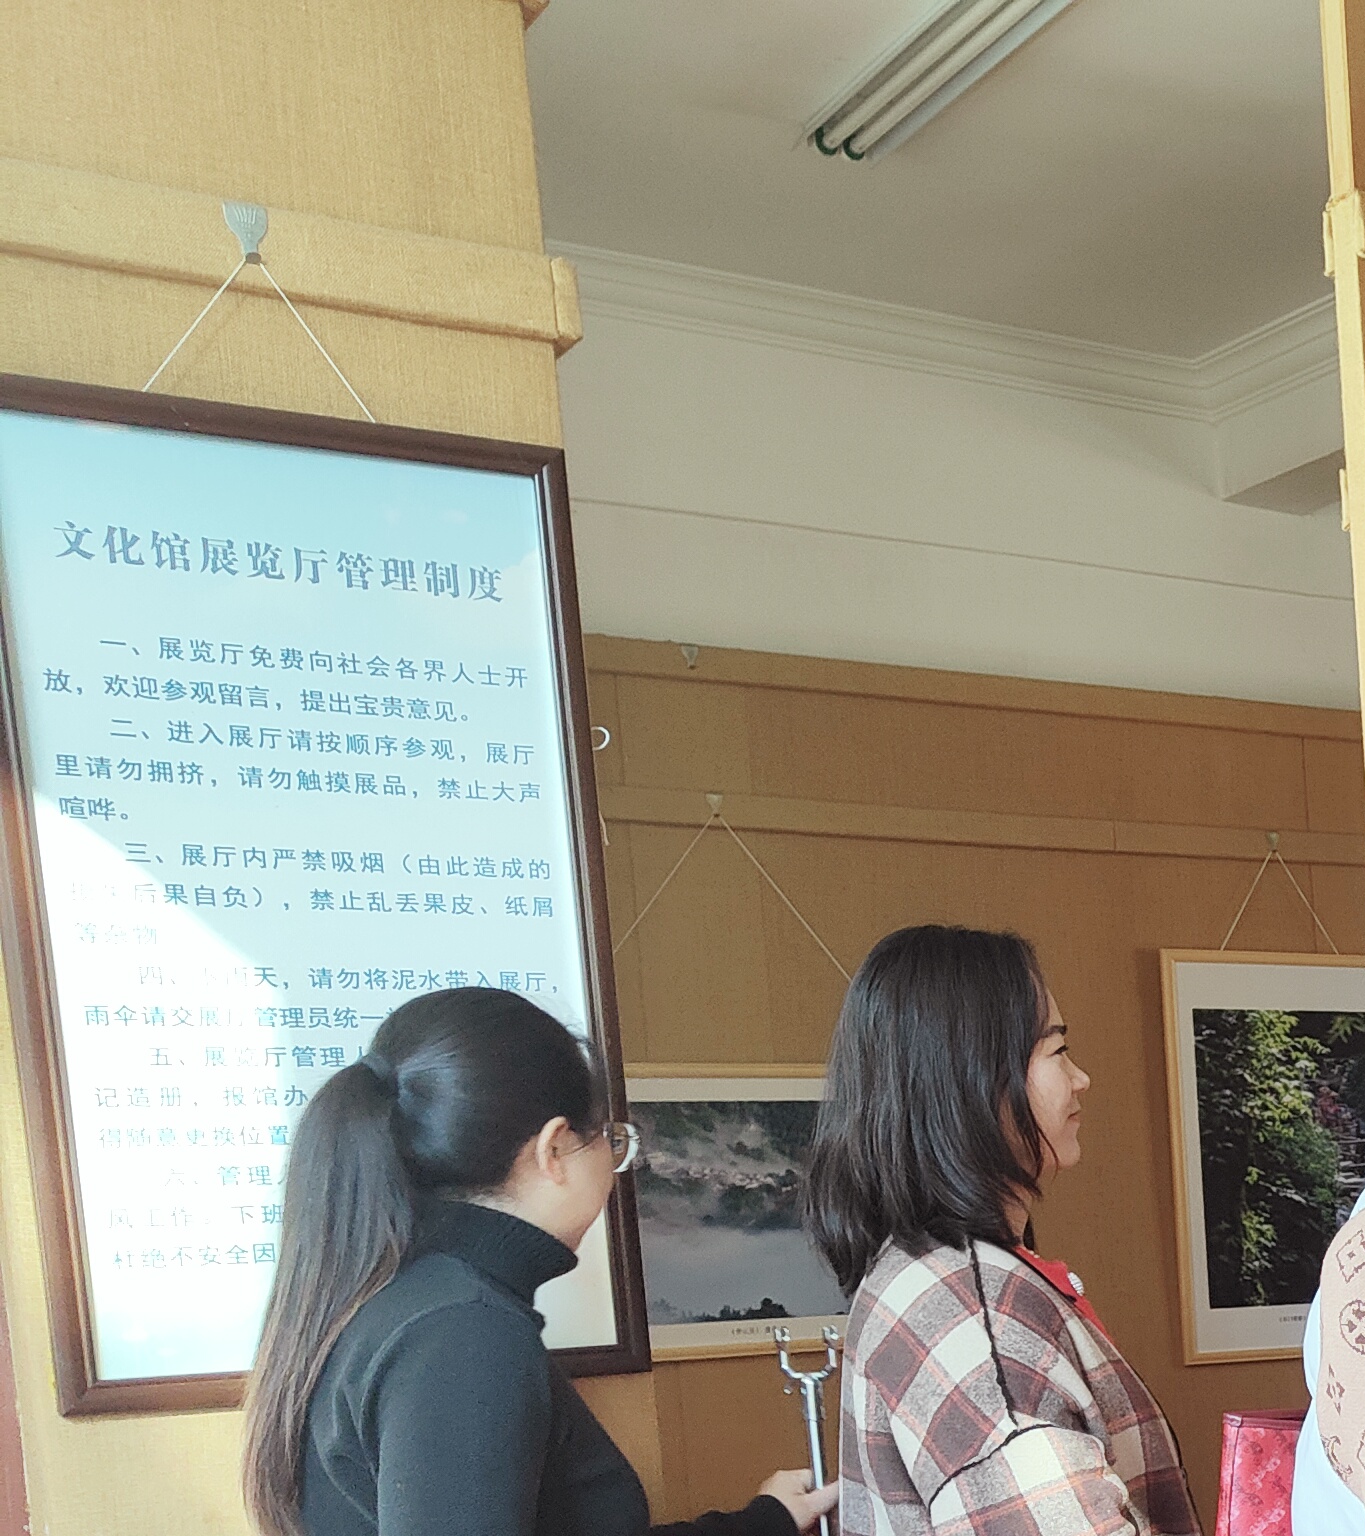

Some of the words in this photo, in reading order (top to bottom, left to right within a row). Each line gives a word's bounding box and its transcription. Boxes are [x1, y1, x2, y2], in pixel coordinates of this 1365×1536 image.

[53, 520, 504, 603] 文化馆展览厅管理制度
[100, 635, 529, 689] 一、展览厅免费向社会各界人士开
[43, 667, 471, 723] 放，欢迎参观留言，提出宝贵意见。
[109, 718, 536, 766] 二、进入展厅请按顺序参观，展厅
[54, 754, 542, 803] 里请勿拥挤，请勿触摸展品，禁止大声
[58, 796, 131, 823] 喧哗。
[124, 841, 551, 882] 三、展厅内严禁吸烟（由此造成的
[70, 881, 555, 919] 后果自负），禁止乱丢果皮、纸屑
